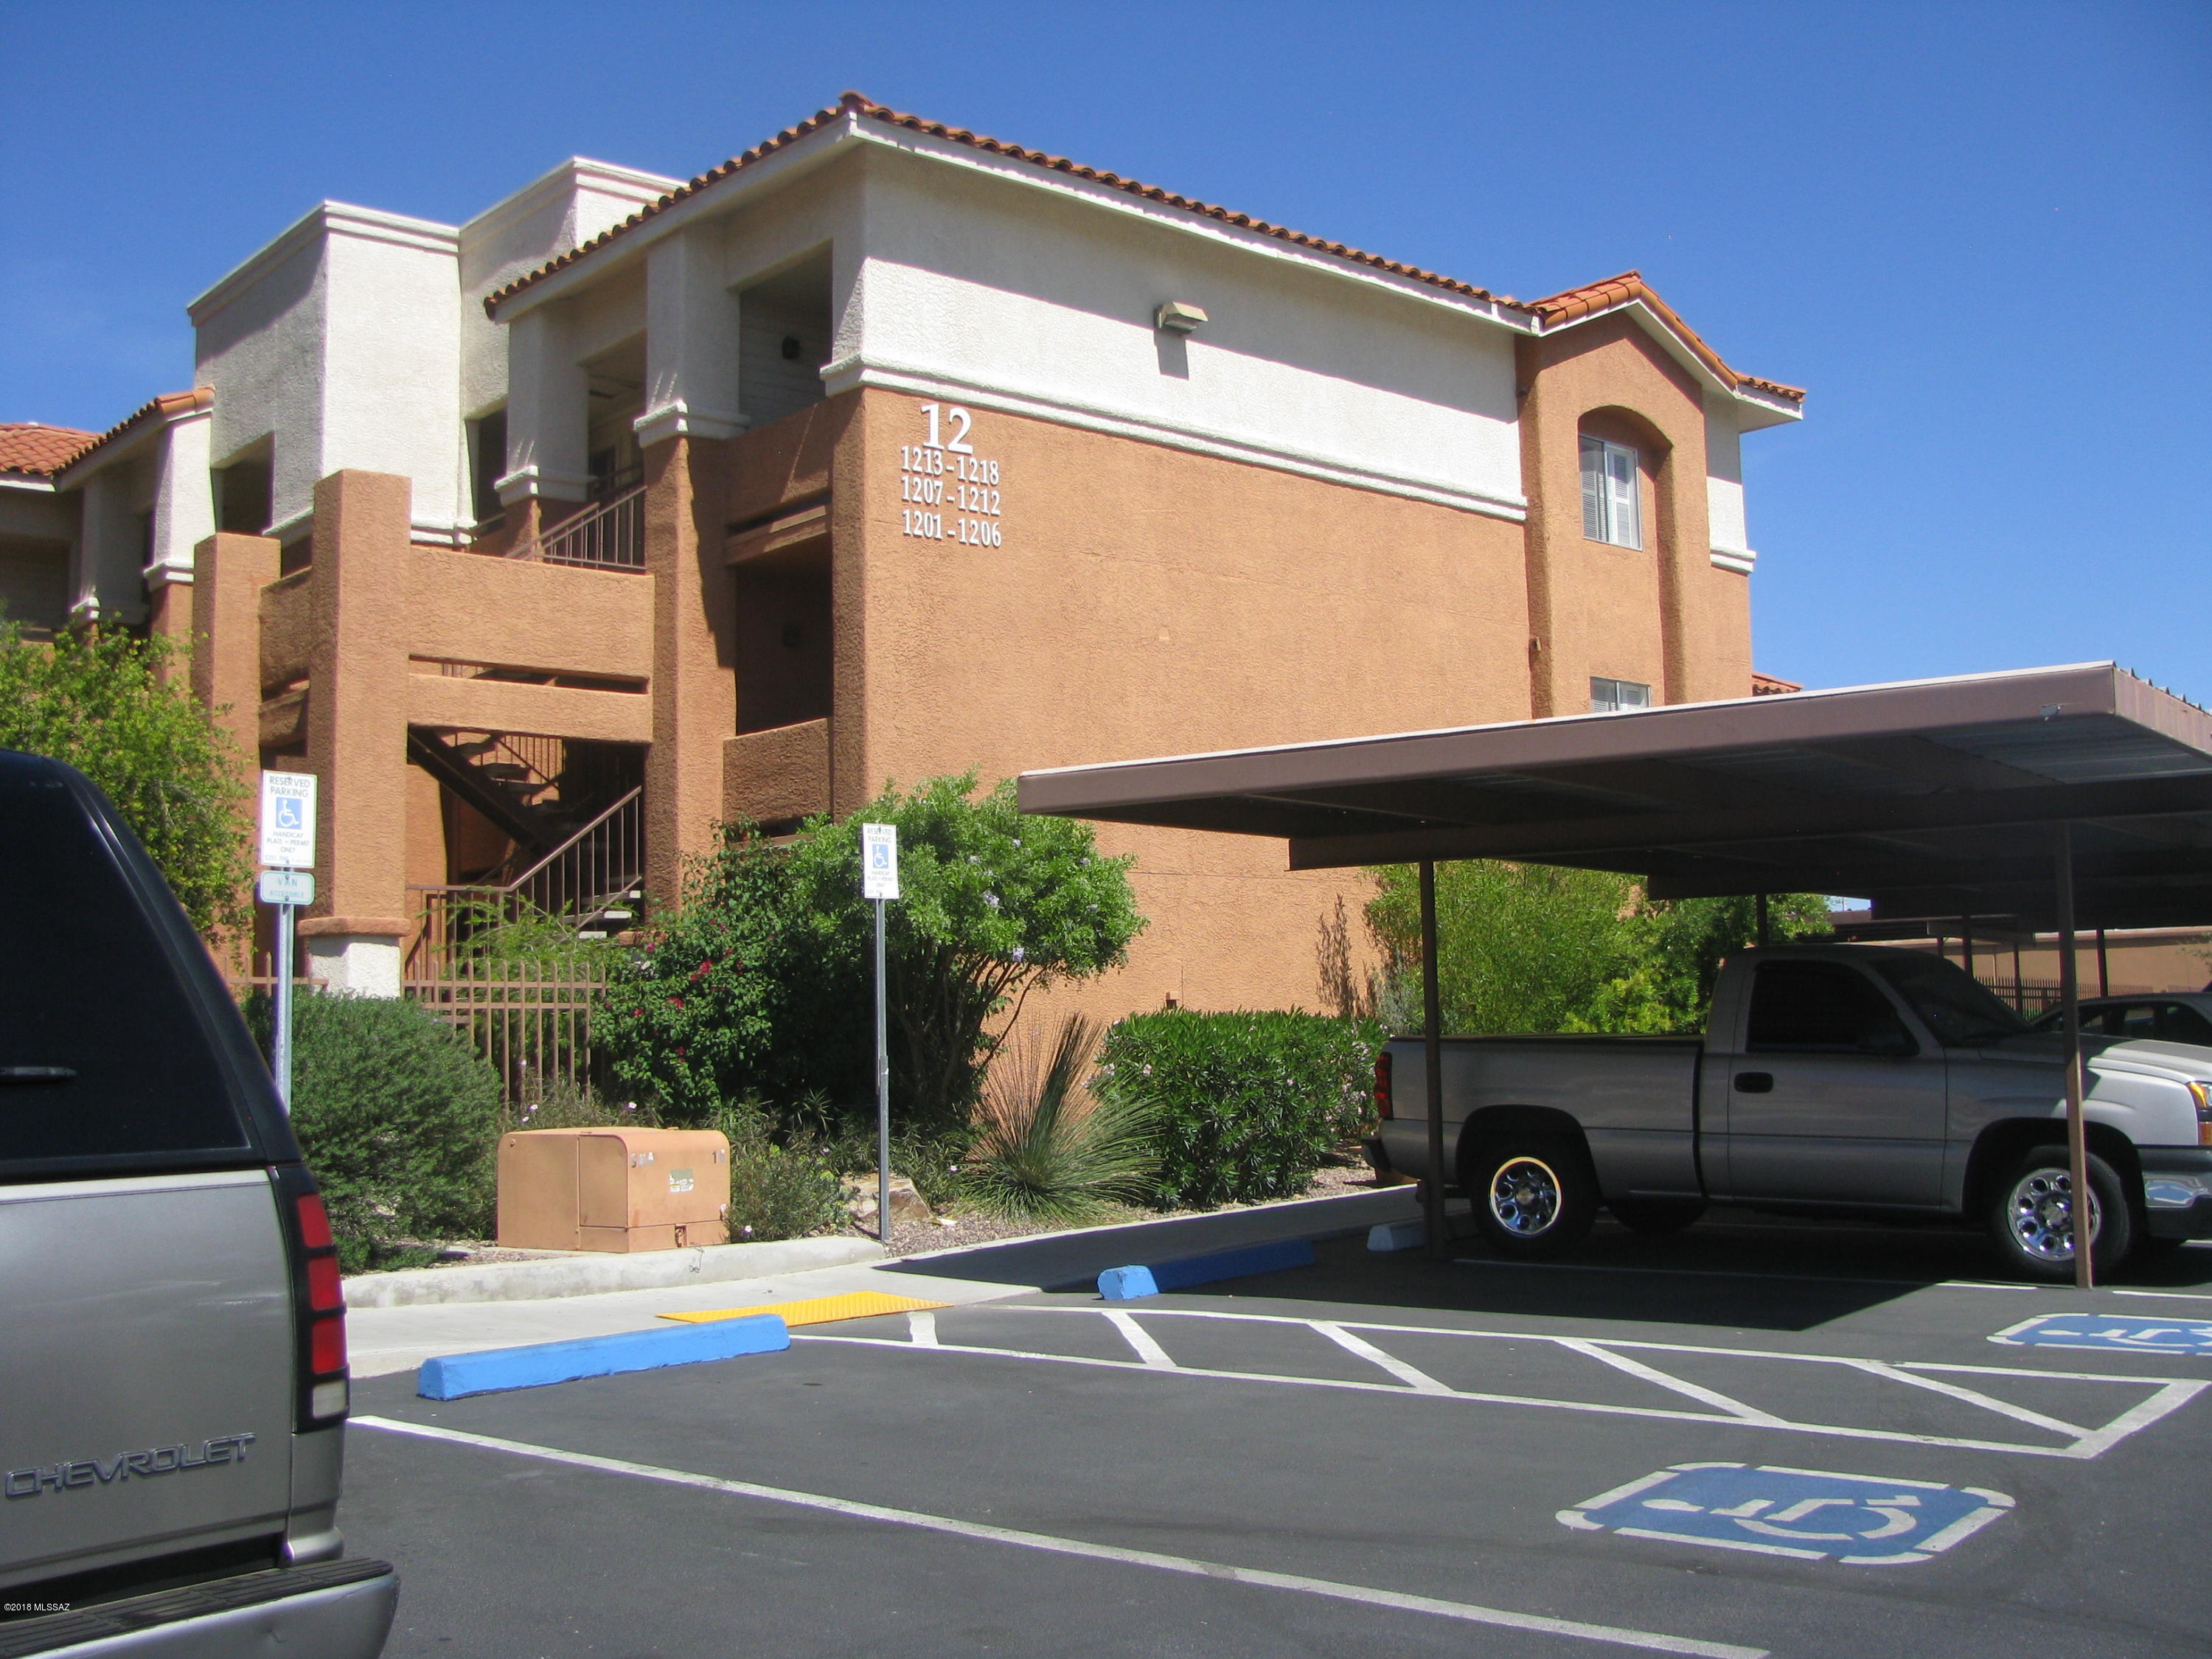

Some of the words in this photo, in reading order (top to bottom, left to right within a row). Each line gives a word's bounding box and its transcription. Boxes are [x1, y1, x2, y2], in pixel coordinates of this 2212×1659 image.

[920, 403, 973, 454] 12
[269, 776, 310, 788] RESERVED
[271, 786, 309, 798] PARKING
[278, 878, 298, 887] VAN
[5, 1432, 256, 1497] CHEVROLET
